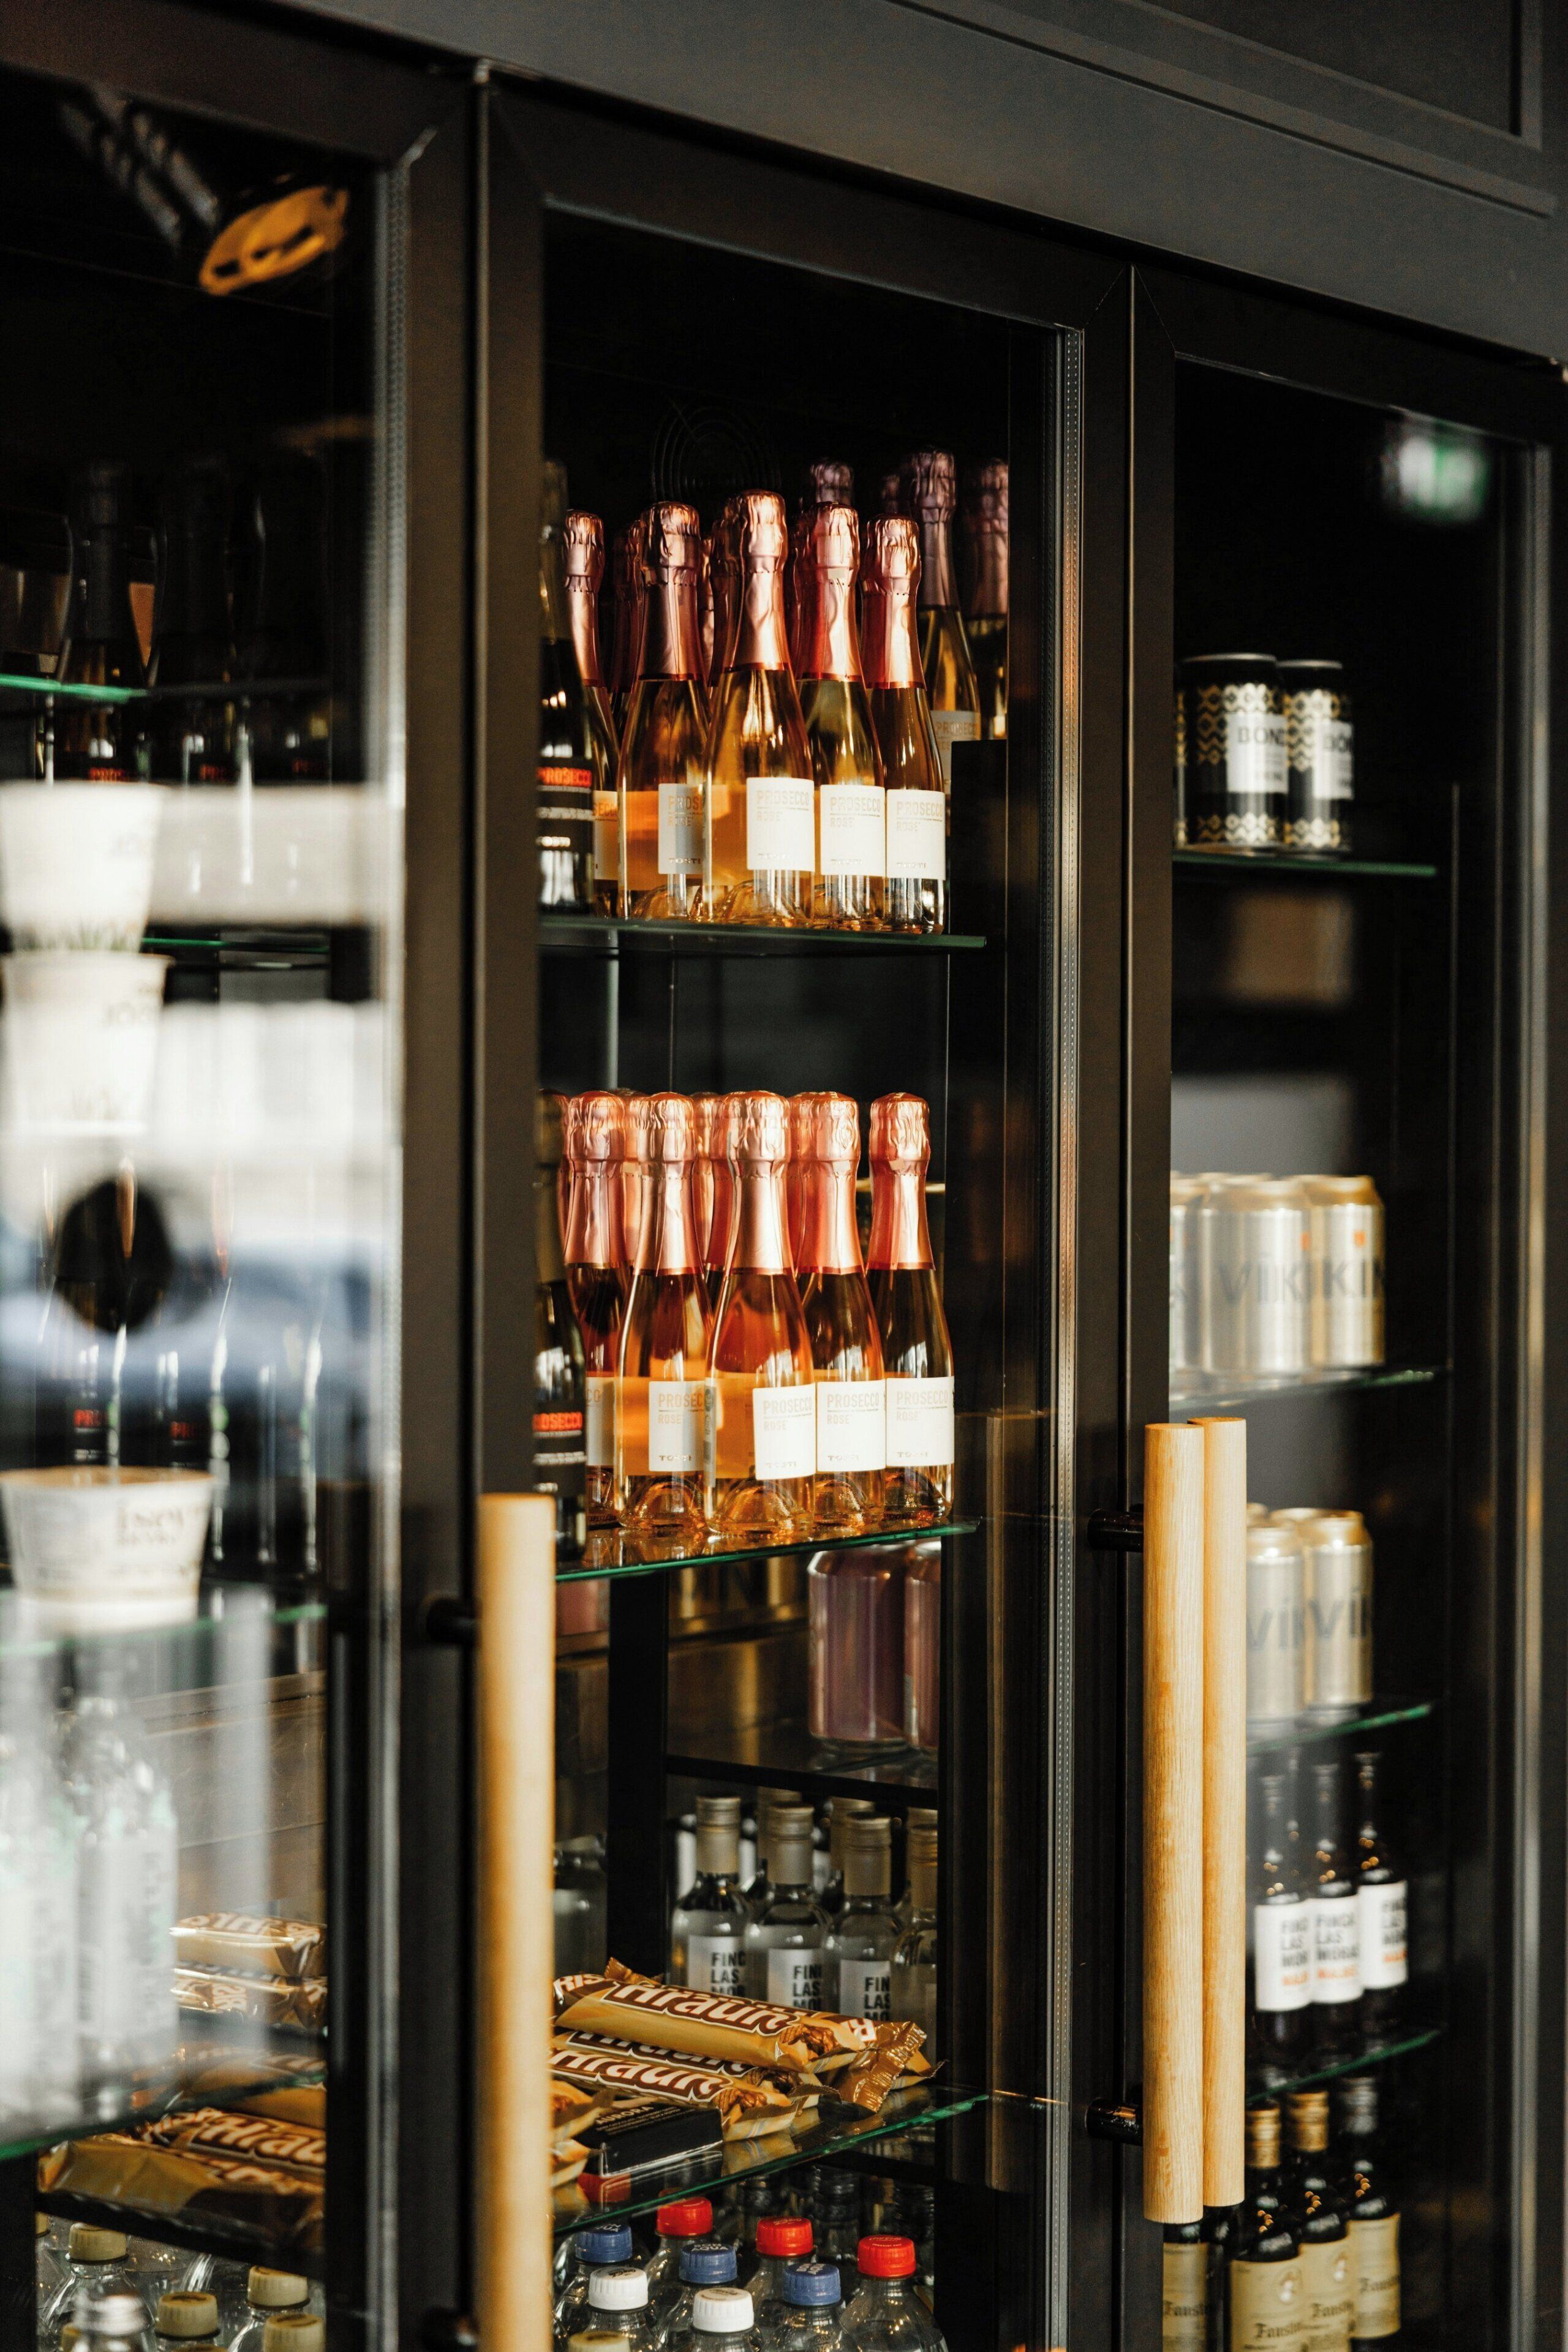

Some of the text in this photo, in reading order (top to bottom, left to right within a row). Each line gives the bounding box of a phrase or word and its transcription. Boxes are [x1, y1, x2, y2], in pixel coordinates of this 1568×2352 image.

[757, 790, 809, 806] PROSECCO
[831, 796, 881, 813] PROSECCO
[897, 801, 943, 816] PROSECCO
[763, 1396, 813, 1415] PROSECCO
[827, 1392, 880, 1408] PROSECCO
[897, 1390, 949, 1405] PROSECCO
[712, 1968, 739, 1984] LAS
[793, 1981, 820, 1997] LAS
[612, 1983, 790, 2030] Hraun
[596, 2106, 654, 2125] AURORA
